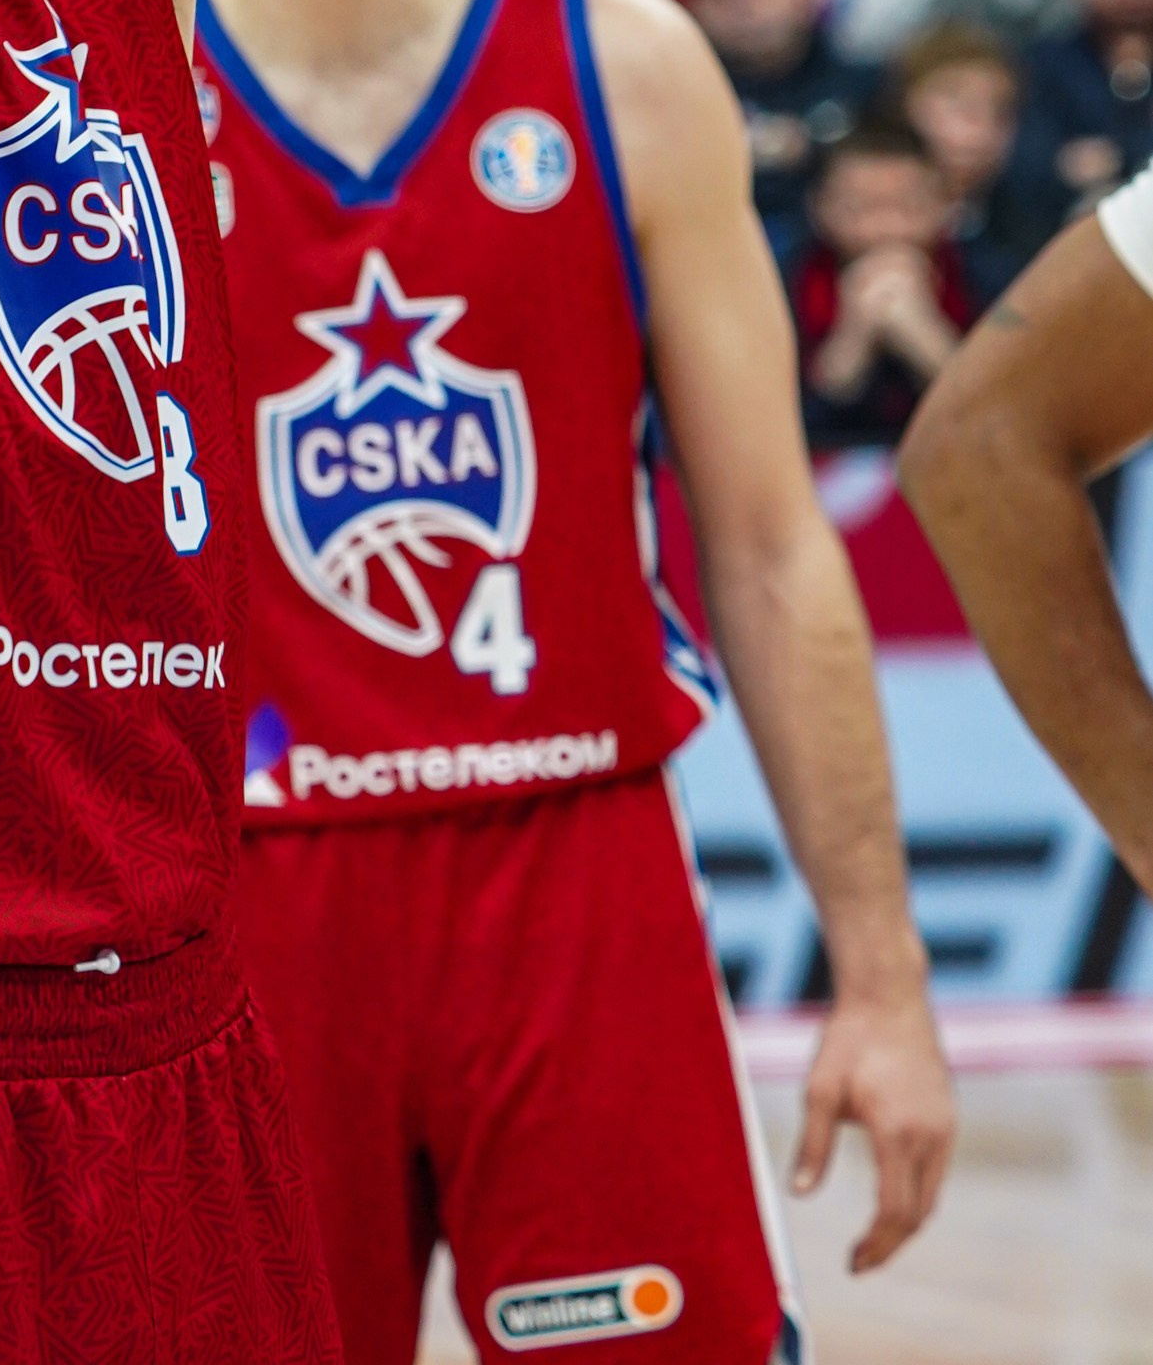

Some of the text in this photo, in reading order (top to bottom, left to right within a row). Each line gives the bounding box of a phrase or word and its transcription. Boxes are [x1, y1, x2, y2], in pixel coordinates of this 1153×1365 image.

[4, 181, 144, 265] CSK
[155, 390, 213, 558] 8
[297, 411, 499, 499] CSKA
[449, 562, 538, 696] 4
[288, 728, 619, 801] Ростелеком
